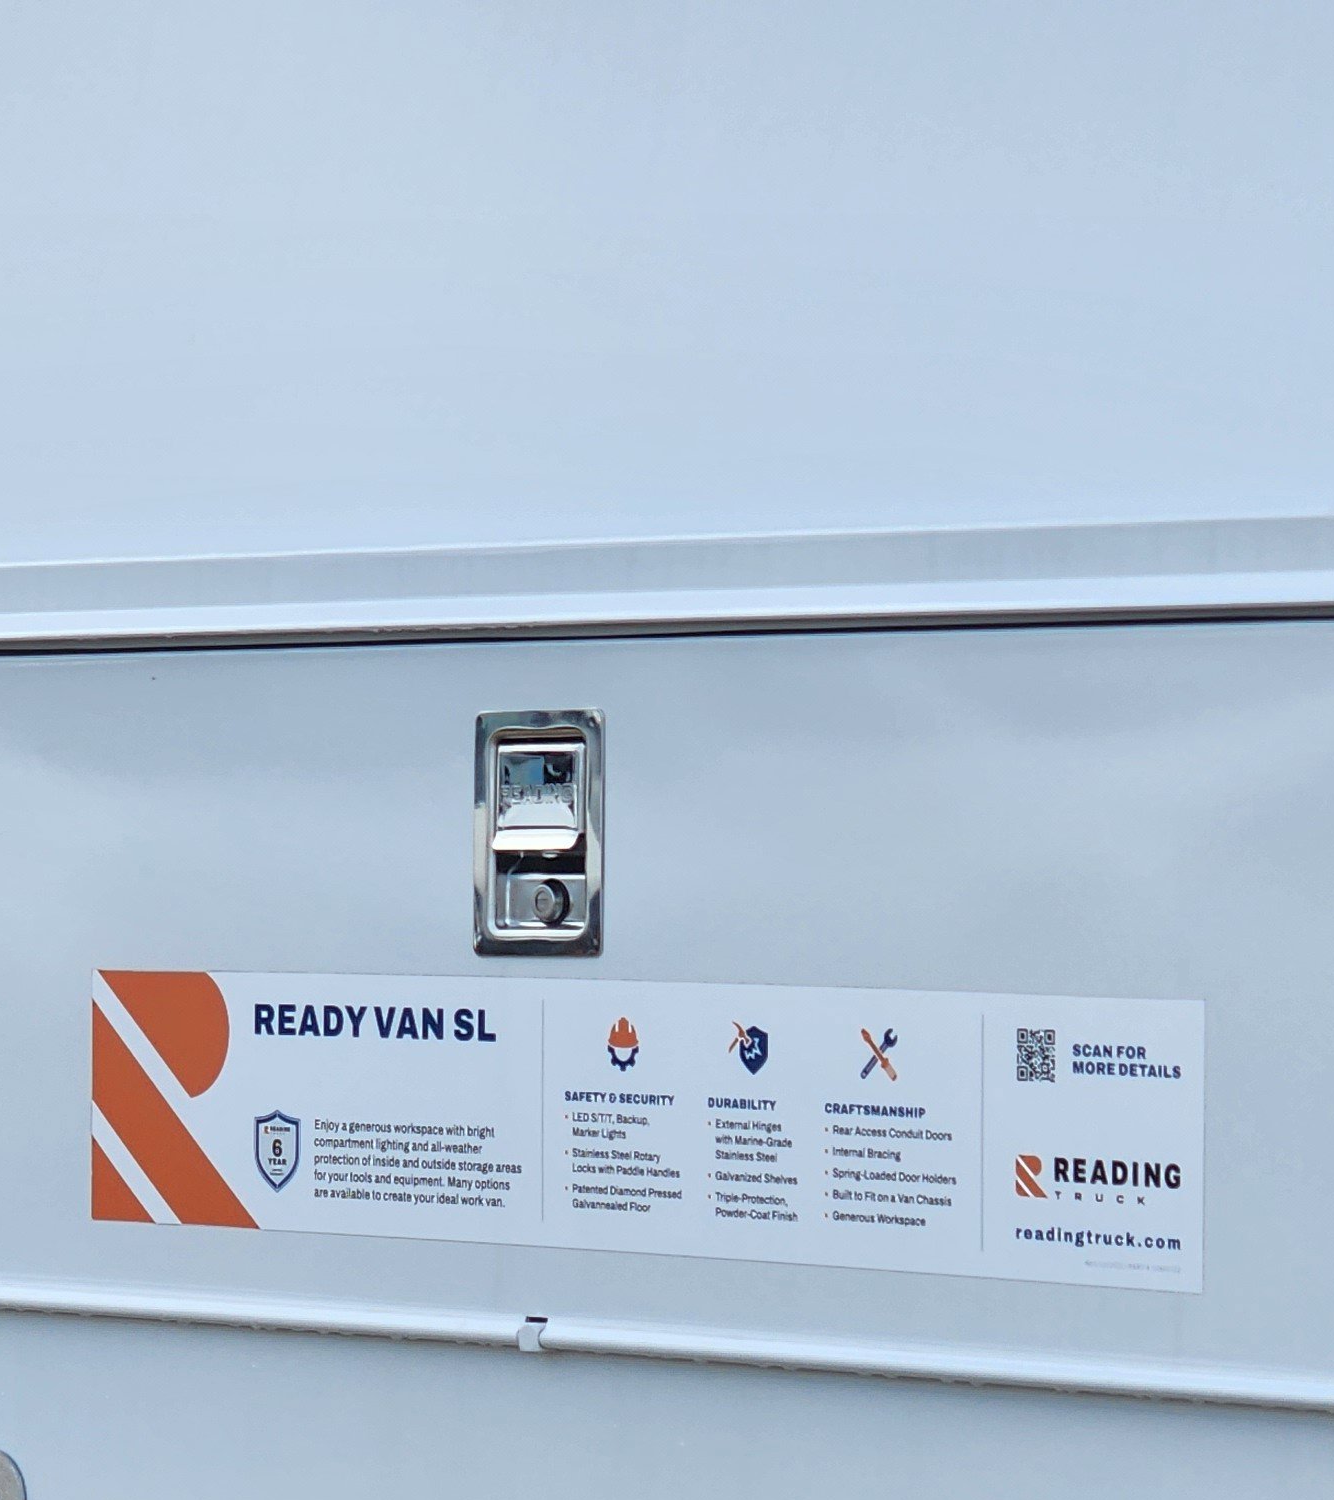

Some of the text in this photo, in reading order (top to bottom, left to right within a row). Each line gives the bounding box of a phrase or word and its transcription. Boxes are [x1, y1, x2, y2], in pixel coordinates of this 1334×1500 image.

[255, 1004, 496, 1042] READY VAN SL
[1072, 1044, 1146, 1059] SCAN FOR
[1072, 1062, 1181, 1079] MORE DETAILS
[565, 1091, 606, 1102] SAFETY
[619, 1093, 674, 1105] SECURITY
[708, 1097, 776, 1110] DURABILITY
[825, 1103, 925, 1118] CRAFTSMANSHIP
[572, 1112, 589, 1122] LED
[617, 1114, 650, 1125] Backup,
[715, 1119, 781, 1133] External Hinges
[315, 1119, 494, 1139] Enjoy a generous workspace with bright
[573, 1127, 626, 1140] Marker Lights
[833, 1125, 952, 1140] Rear Access Conduit Doors
[272, 1139, 282, 1157] 6
[314, 1138, 482, 1154] compartment lighting and all-weather
[716, 1135, 792, 1148] with Marine-Grade
[573, 1148, 660, 1164] Stainless Steel Rotary
[715, 1150, 777, 1162] Stainless Steel
[833, 1147, 901, 1162] Internal Bracing
[314, 1154, 522, 1174] protection of inside and outside storage areas
[572, 1163, 680, 1178] Locks with Paddle Handles
[314, 1169, 510, 1191] for your tools and equipment. Many options
[715, 1171, 797, 1185] Galvanized Shelves
[833, 1168, 956, 1184] Spring-Loaded Door Holders
[1054, 1157, 1181, 1189] READING
[314, 1188, 505, 1208] are available to create your ideal work van.
[573, 1184, 682, 1199] Patented Diamond Pressed
[833, 1189, 852, 1200] Built
[855, 1191, 862, 1200] to
[865, 1192, 876, 1202] Fit
[877, 1194, 888, 1202] on
[898, 1194, 914, 1203] Van
[917, 1195, 951, 1206] Chassis
[1055, 1191, 1145, 1205] TRUCK
[630, 1202, 650, 1212] Floor
[715, 1208, 798, 1221] Powder-Coat Finish
[833, 1211, 925, 1226] Generous Workspace
[1015, 1227, 1181, 1250] readingtruck.com
